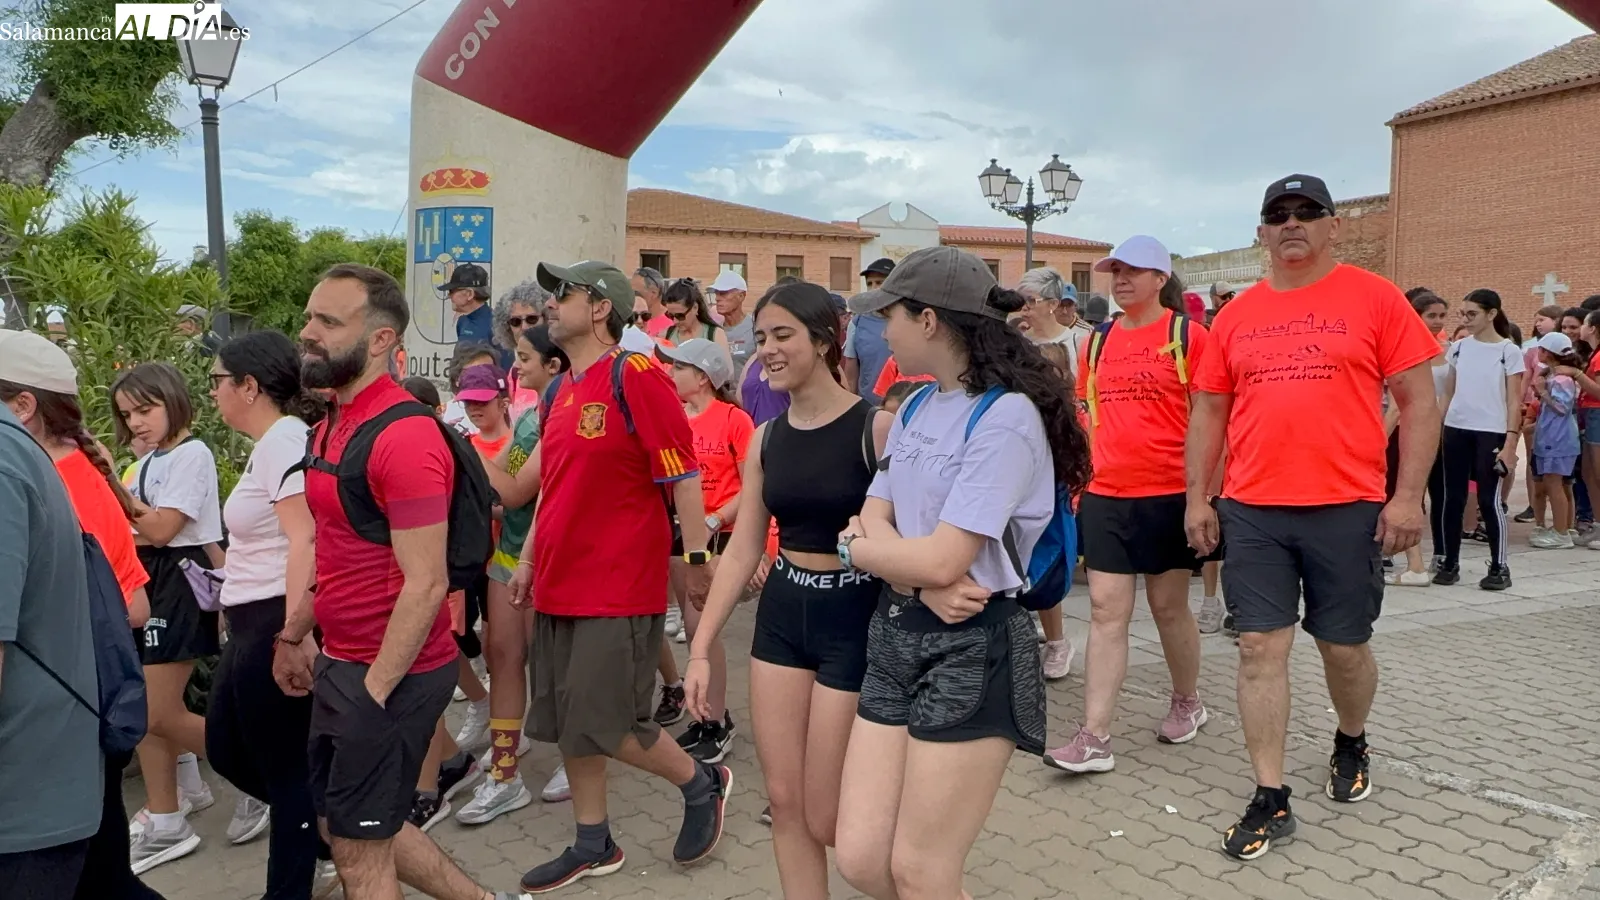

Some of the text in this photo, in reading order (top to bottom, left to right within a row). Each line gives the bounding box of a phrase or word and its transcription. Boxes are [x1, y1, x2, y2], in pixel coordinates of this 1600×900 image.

[444, 6, 501, 80] CON
[407, 347, 453, 378] iputa
[787, 567, 834, 589] NIKE
[838, 571, 872, 588] PR
[145, 629, 159, 647] 91
